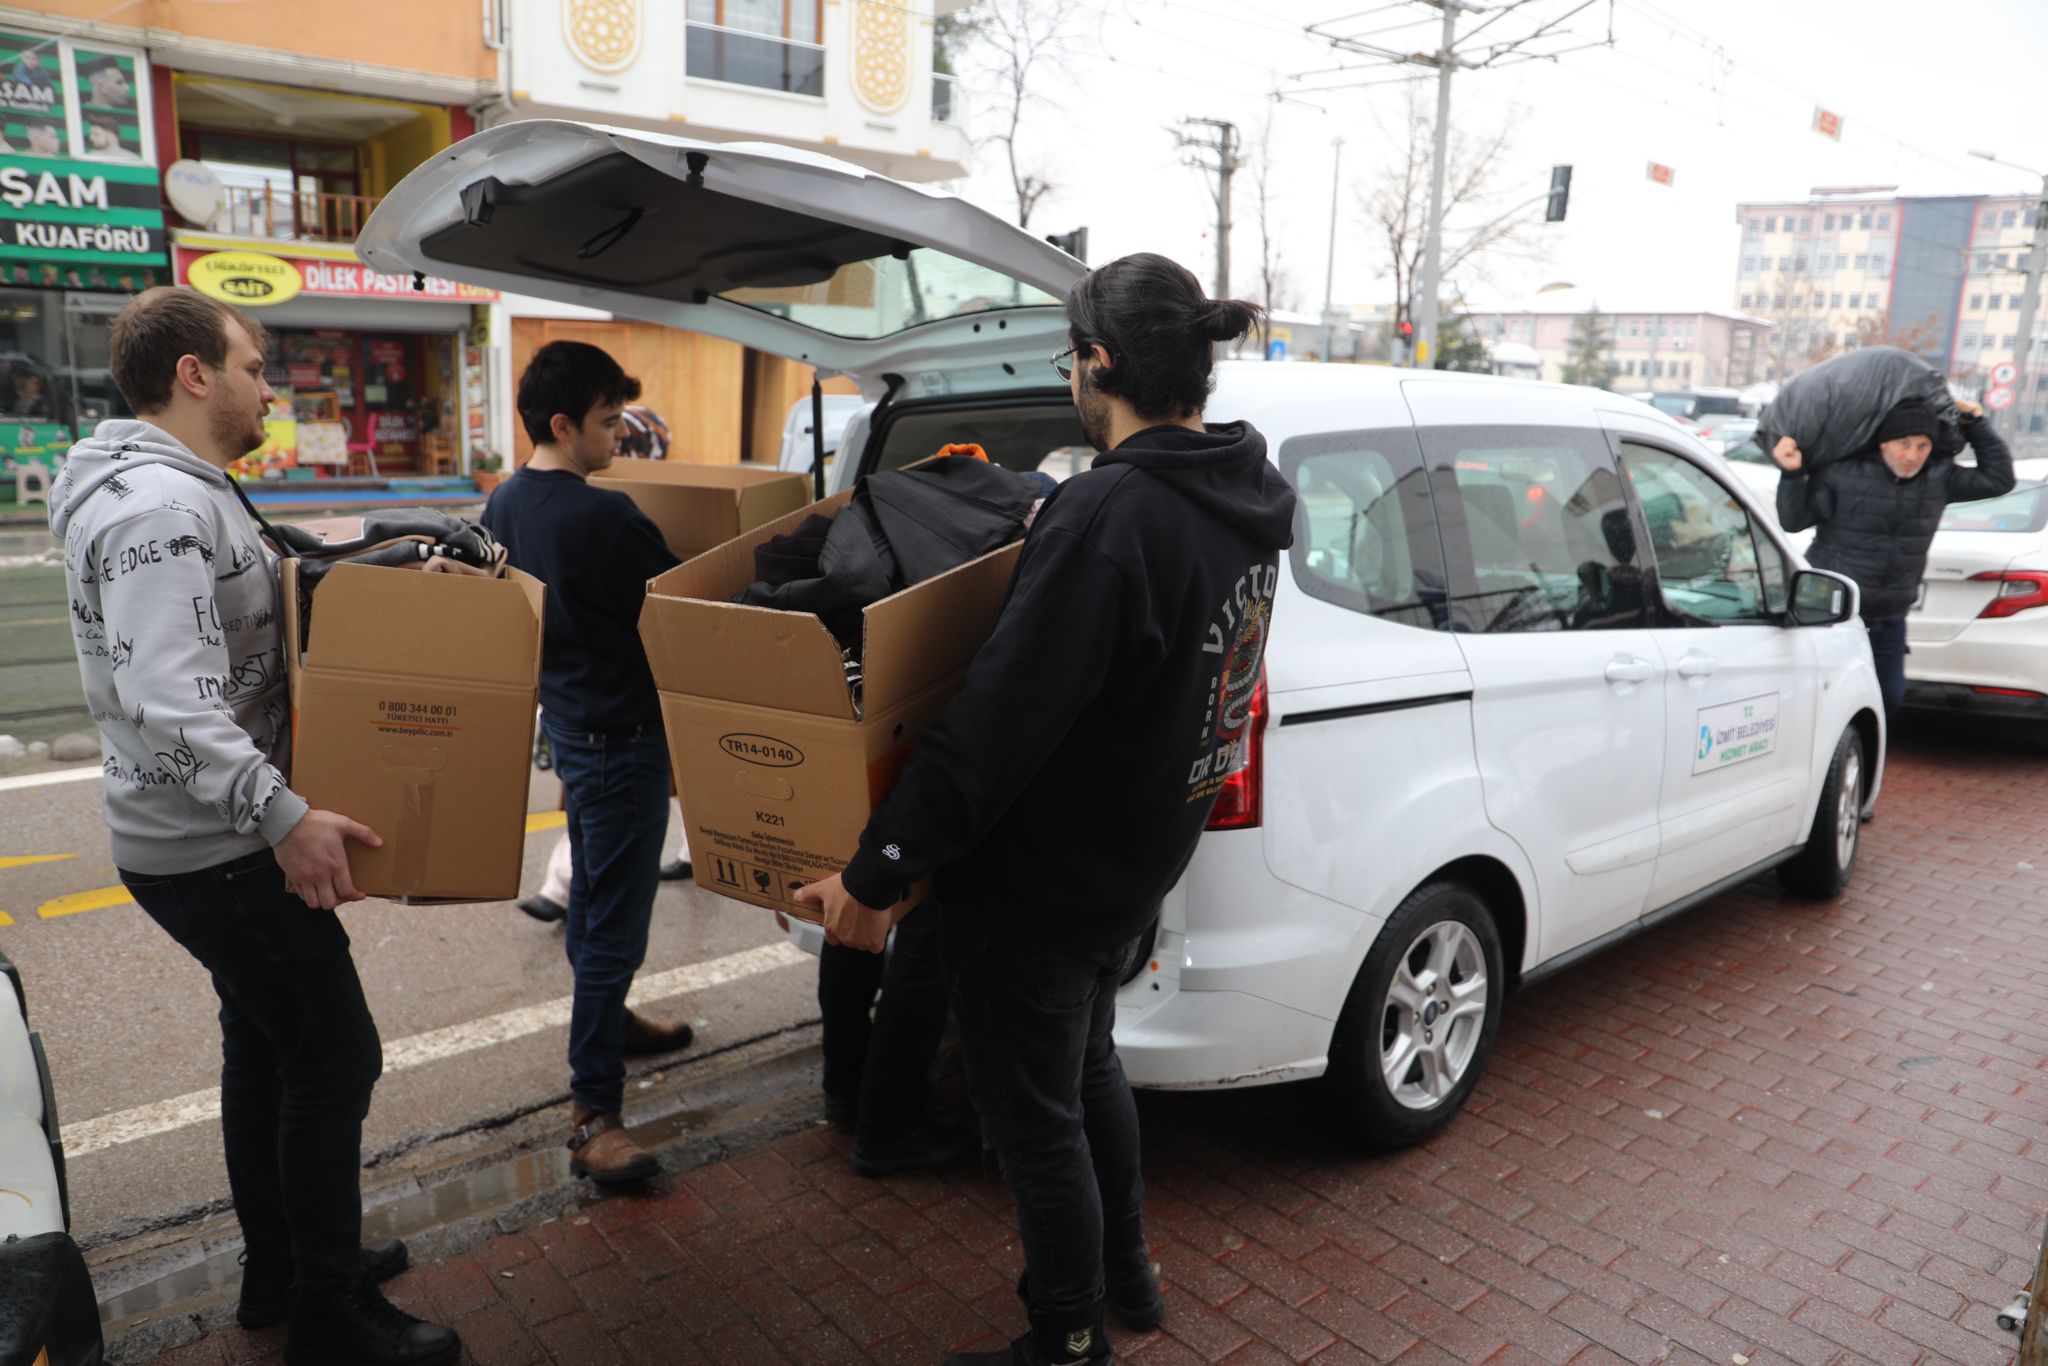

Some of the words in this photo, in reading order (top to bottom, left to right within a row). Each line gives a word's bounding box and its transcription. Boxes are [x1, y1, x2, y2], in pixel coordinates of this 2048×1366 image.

[16, 222, 151, 254] KUAFÖRÜ
[306, 261, 358, 291] DİLEK
[119, 539, 163, 576] EDGE
[379, 701, 385, 710] 0
[388, 702, 407, 712] 800
[409, 703, 427, 713] 344
[430, 705, 443, 715] 00
[445, 706, 456, 716] 01
[386, 713, 423, 722] TÜKETİCİ
[1716, 727, 1736, 745] İZMİT
[726, 739, 794, 761] TR14-0140
[755, 811, 785, 827] K221
